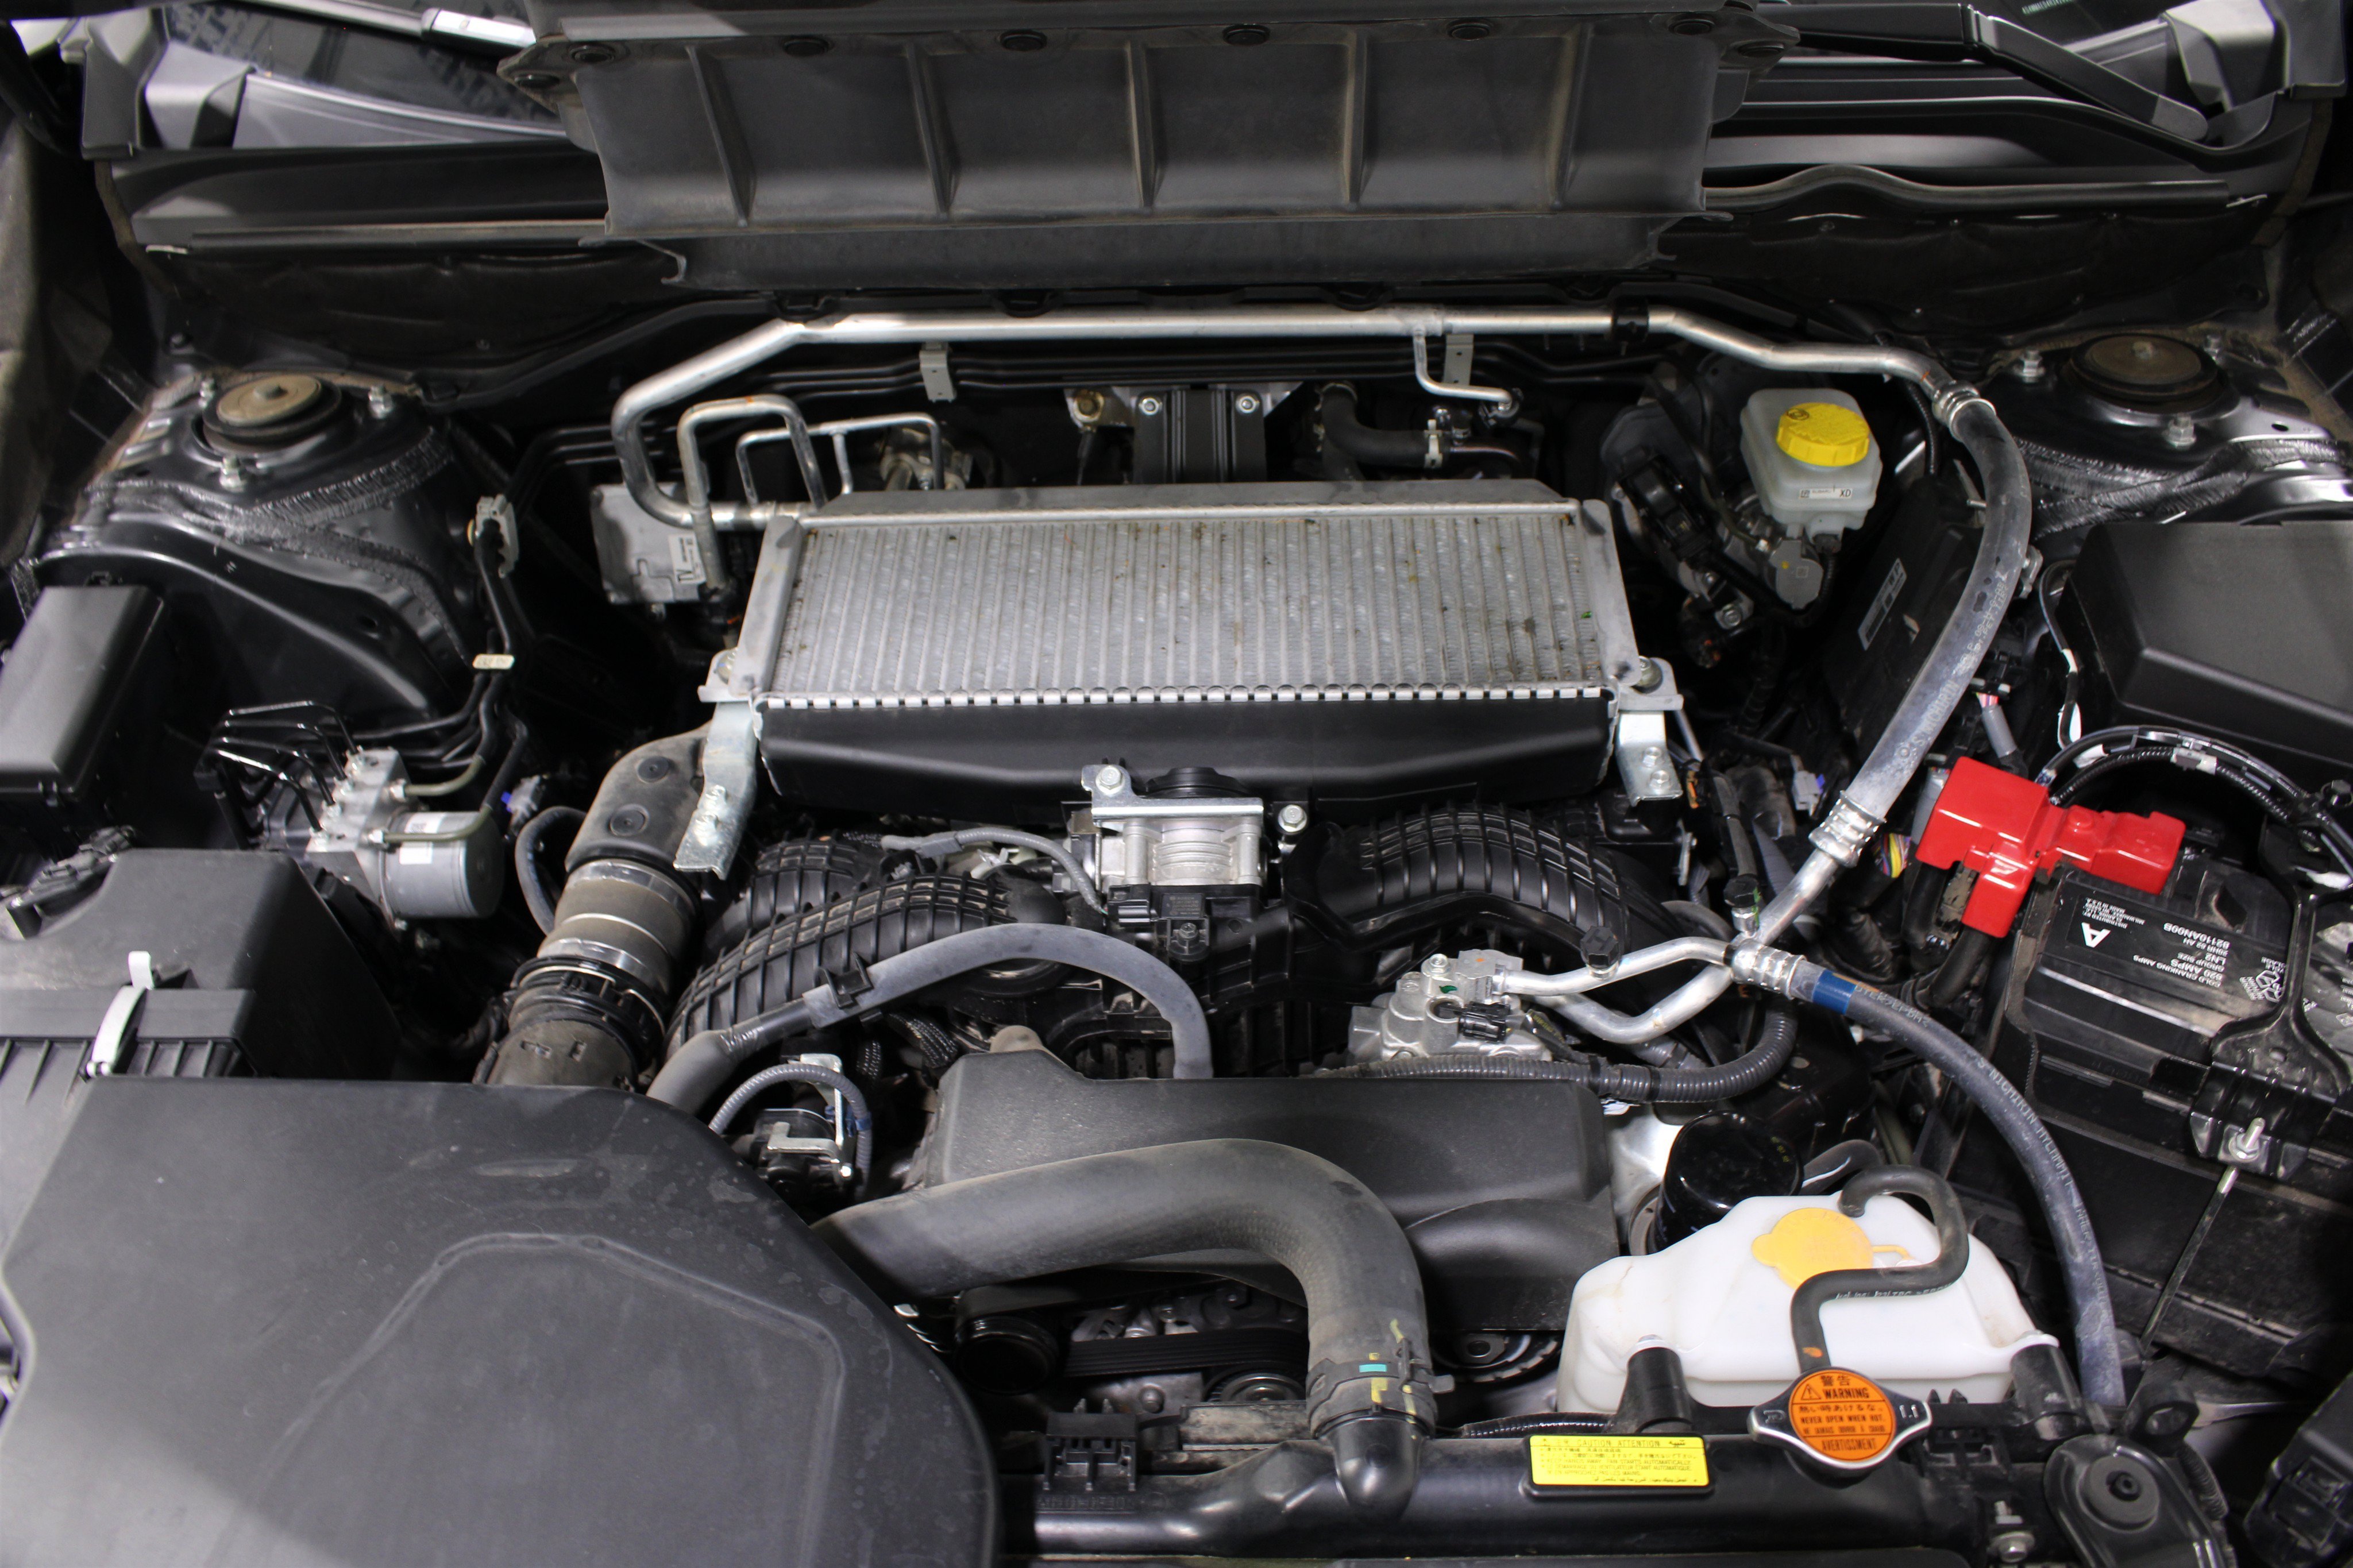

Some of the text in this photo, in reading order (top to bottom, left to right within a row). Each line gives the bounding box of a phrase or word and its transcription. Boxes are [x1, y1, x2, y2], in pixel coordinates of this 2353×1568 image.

[1839, 489, 1851, 497] XD
[2090, 913, 2128, 929] DISTRIBUTED
[2182, 937, 2196, 947] AH
[2177, 951, 2225, 972] GROUP SIZE
[2204, 952, 2226, 965] LN2
[2132, 954, 2221, 988] COLD CRANKING AMPS
[2170, 958, 2202, 974] AMPS
[1988, 1068, 2038, 1125] NICHIRIN
[1820, 1375, 1850, 1387] 警告
[1822, 1388, 1869, 1399] WARNING
[1800, 1416, 1822, 1424] NEVER
